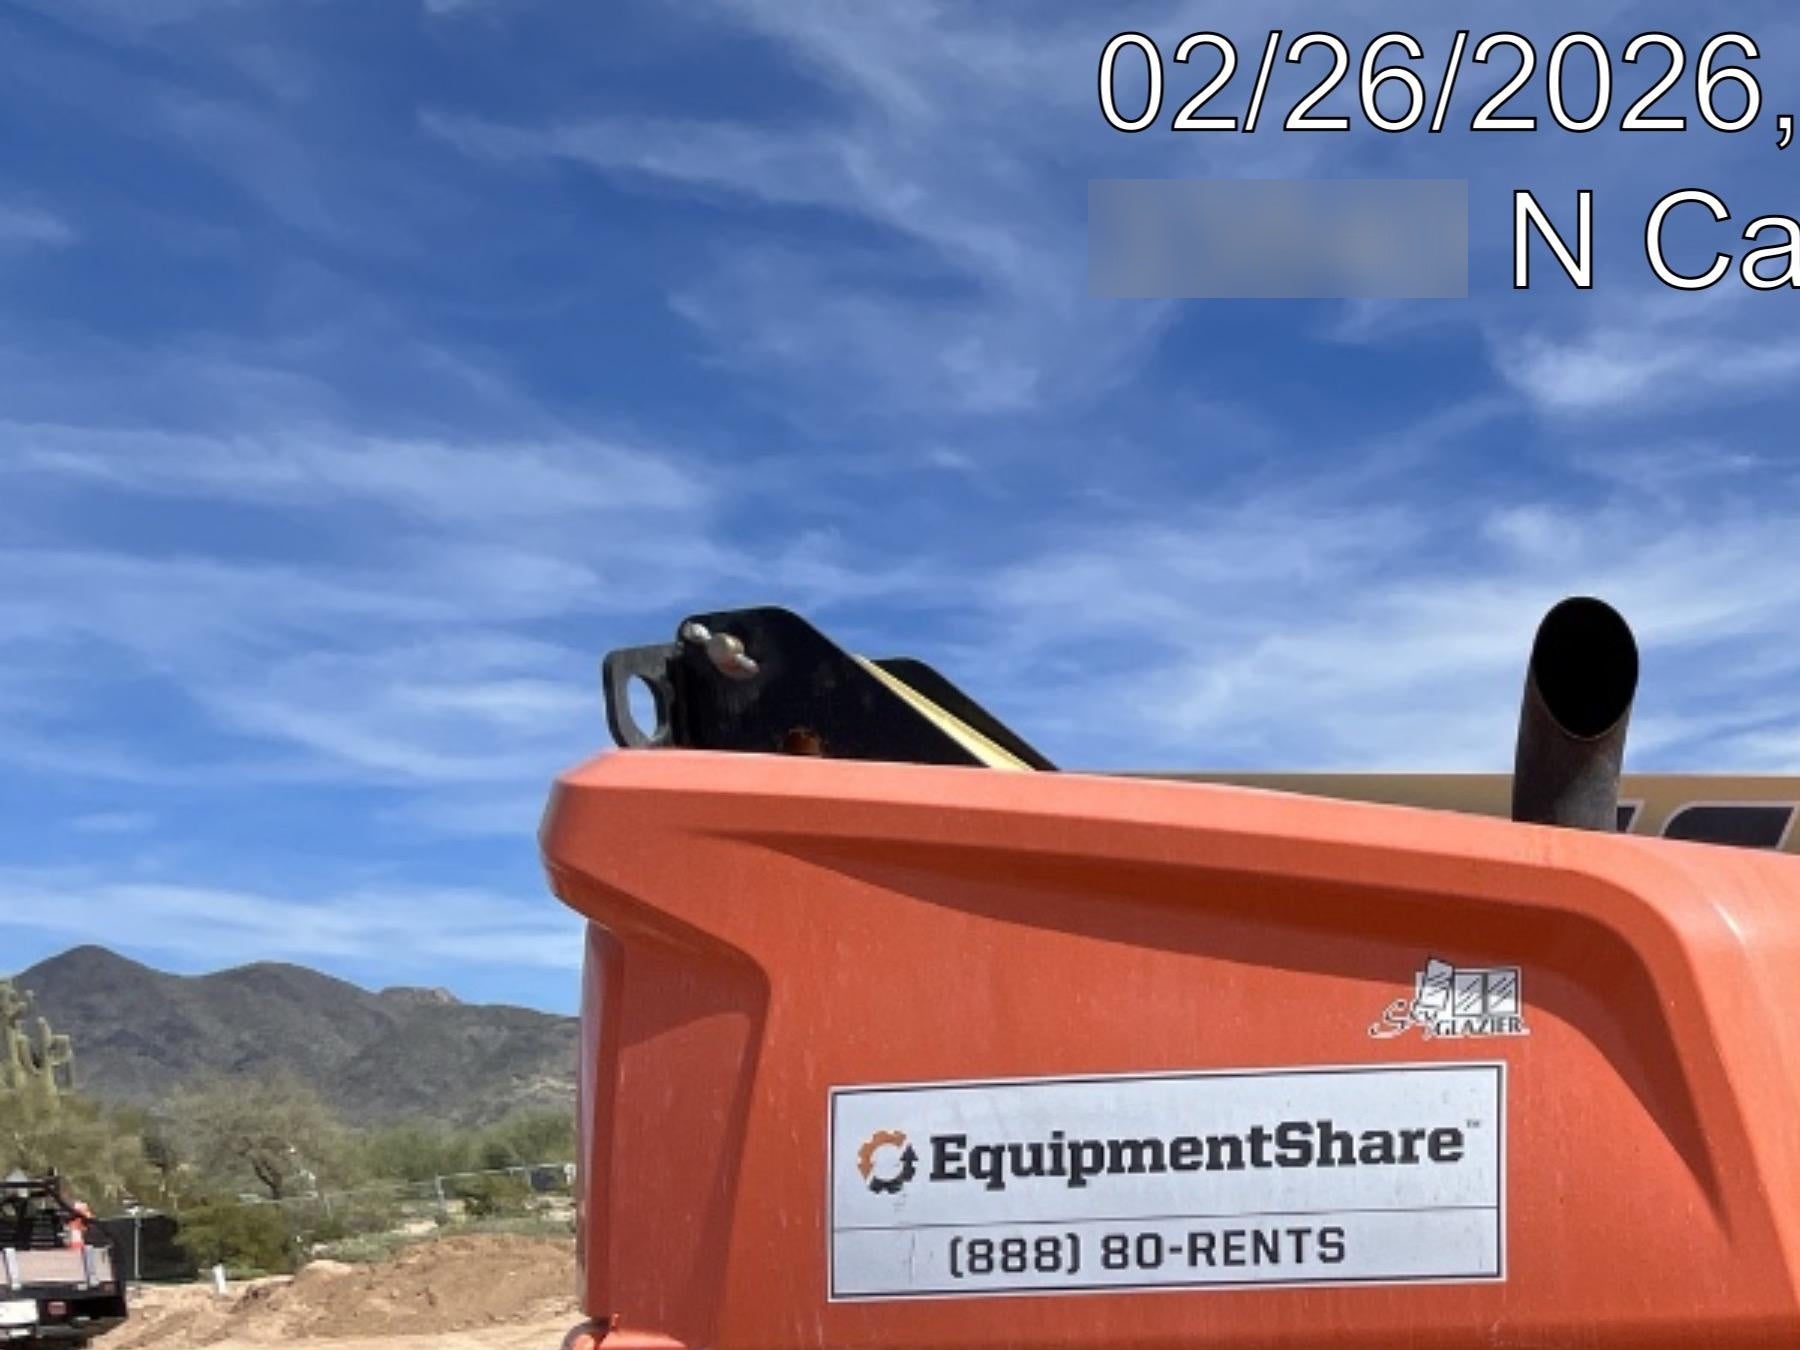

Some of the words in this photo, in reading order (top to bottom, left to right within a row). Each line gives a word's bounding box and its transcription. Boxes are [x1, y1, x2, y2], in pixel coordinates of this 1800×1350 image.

[930, 1119, 1466, 1189] EquipmentShare
[949, 1232, 1083, 1279] (888)
[1101, 1226, 1347, 1272] 80-RENTS
